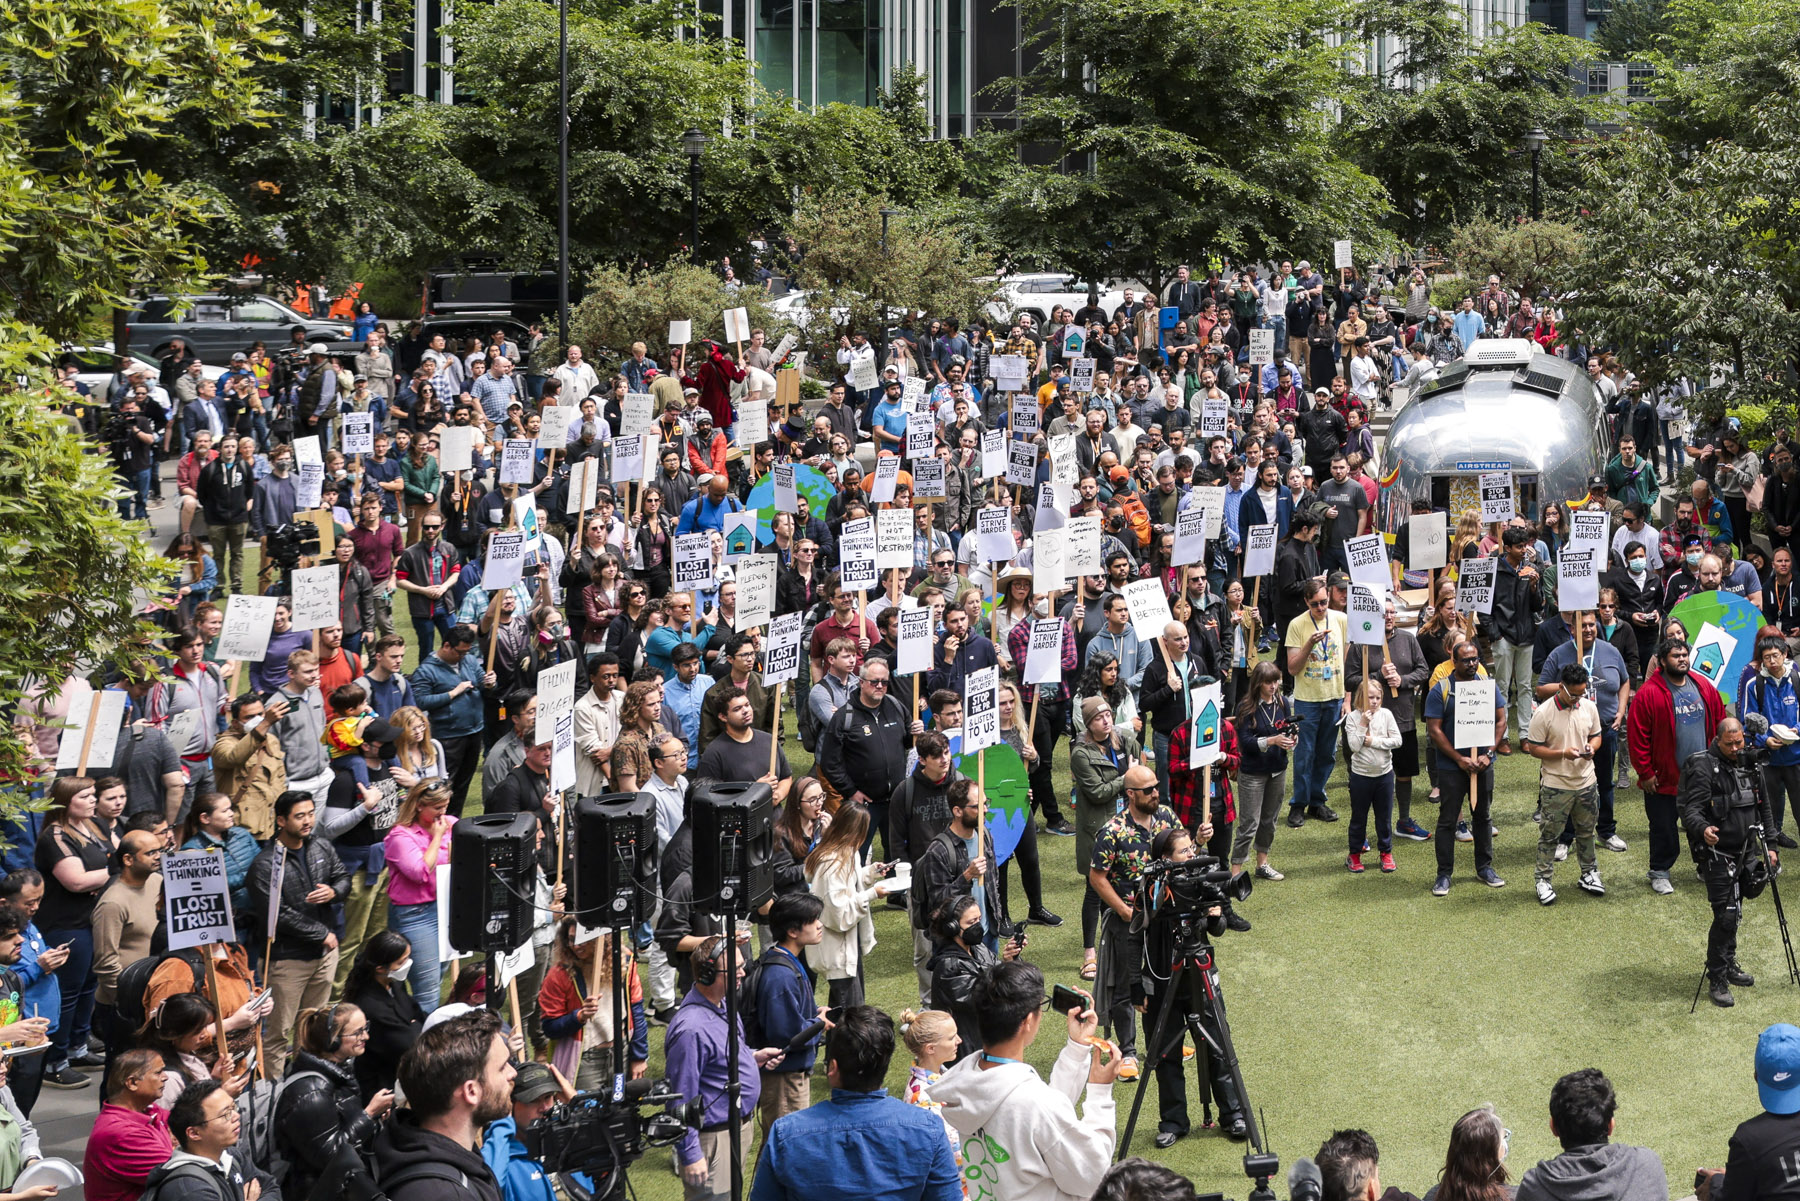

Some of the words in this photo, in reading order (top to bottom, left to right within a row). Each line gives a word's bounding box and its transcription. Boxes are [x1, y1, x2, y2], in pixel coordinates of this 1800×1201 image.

[985, 440, 1002, 448] STRIVE
[986, 445, 1003, 453] HARDER
[1022, 471, 1031, 479] US
[1486, 506, 1496, 514] TO
[1501, 505, 1511, 513] US
[981, 520, 1006, 528] STRIVE
[1180, 521, 1201, 530] STRIVE
[1180, 529, 1201, 538] HARDER
[1575, 532, 1602, 540] HARDER
[676, 536, 709, 546] SHORT-TERM
[842, 537, 874, 546] SHORT-TERM
[493, 545, 520, 553] STRIVE
[677, 543, 709, 553] THINKING
[843, 543, 874, 552] THINKING
[492, 552, 520, 560] HARDER
[1352, 548, 1380, 560] STRIVE
[681, 560, 706, 571] LOST
[847, 561, 871, 571] LOST
[1353, 556, 1382, 567] HARDER
[1562, 562, 1591, 570] STRIVE
[678, 568, 708, 580] TRUST
[845, 569, 874, 580] TRUST
[1562, 570, 1592, 578] HARDER
[742, 583, 767, 597] SHOULD
[1133, 599, 1147, 607] DO
[1138, 607, 1167, 620] BETTER
[771, 615, 800, 629] SHORT-TERM
[902, 622, 928, 632] STRIVE
[771, 624, 799, 639] THINKING
[902, 631, 928, 640] HARDER
[1034, 633, 1058, 642] STRIVE
[1033, 641, 1058, 650] HARDER
[773, 645, 795, 660] LOST
[768, 655, 797, 671] TRUST
[541, 672, 570, 690] THINK
[985, 672, 994, 681] BEST
[969, 679, 994, 695] EMPLOYER?
[973, 692, 990, 707] STOP
[972, 703, 981, 712] THE
[982, 701, 990, 710] PR
[1676, 703, 1704, 715] NASA
[969, 721, 974, 729] &
[976, 713, 994, 727] LISTEN
[969, 726, 980, 739] TO
[984, 720, 995, 734] US
[167, 856, 219, 870] SHORT-TERM
[167, 867, 221, 881] THINKING
[177, 895, 217, 914] LOST
[174, 911, 225, 929] TRUST
